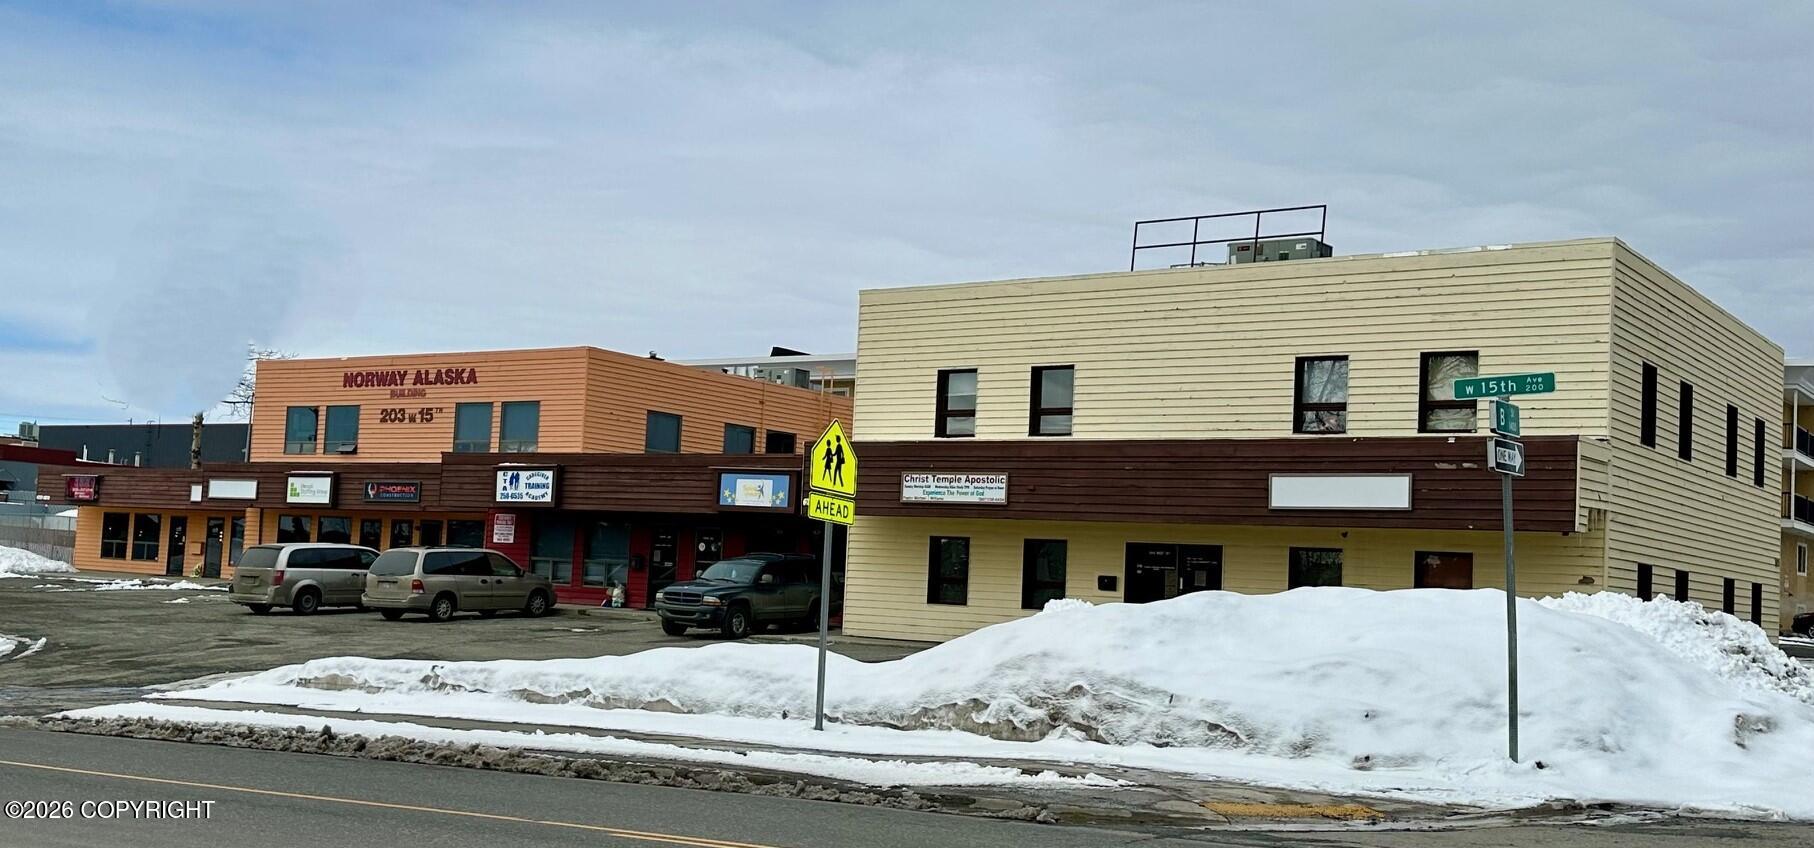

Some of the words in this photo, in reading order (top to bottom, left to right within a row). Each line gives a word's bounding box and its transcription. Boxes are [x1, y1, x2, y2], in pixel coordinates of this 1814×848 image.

[343, 370, 408, 388] NORWAY
[413, 368, 477, 386] ALASKA
[390, 388, 426, 399] BUILDING
[1465, 385, 1474, 395] W
[1481, 380, 1517, 394] 15th
[1525, 384, 1544, 392] 200
[380, 408, 406, 423] 203
[1500, 408, 1505, 426] B
[904, 474, 929, 483] Christ
[932, 474, 962, 485] Temple
[964, 475, 1005, 486] Apostolic
[815, 500, 849, 518] AHEAD
